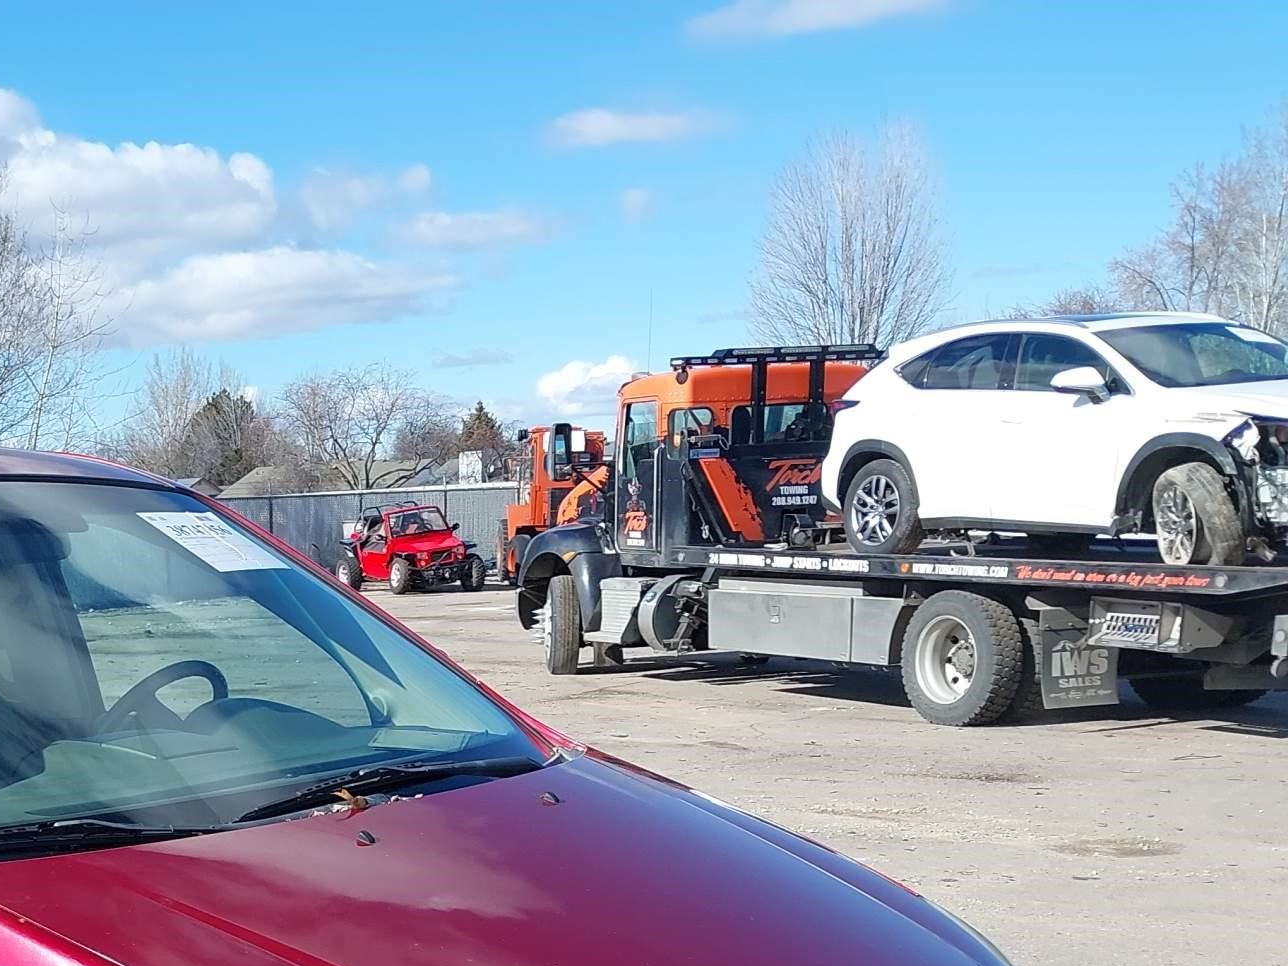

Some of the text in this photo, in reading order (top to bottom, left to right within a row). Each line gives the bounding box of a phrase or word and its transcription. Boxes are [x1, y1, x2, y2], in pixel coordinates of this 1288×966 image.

[780, 485, 809, 495] TOWING
[828, 558, 870, 573] LOCKOUTS
[1051, 648, 1109, 677] IWS
[1058, 675, 1101, 688] SALES
